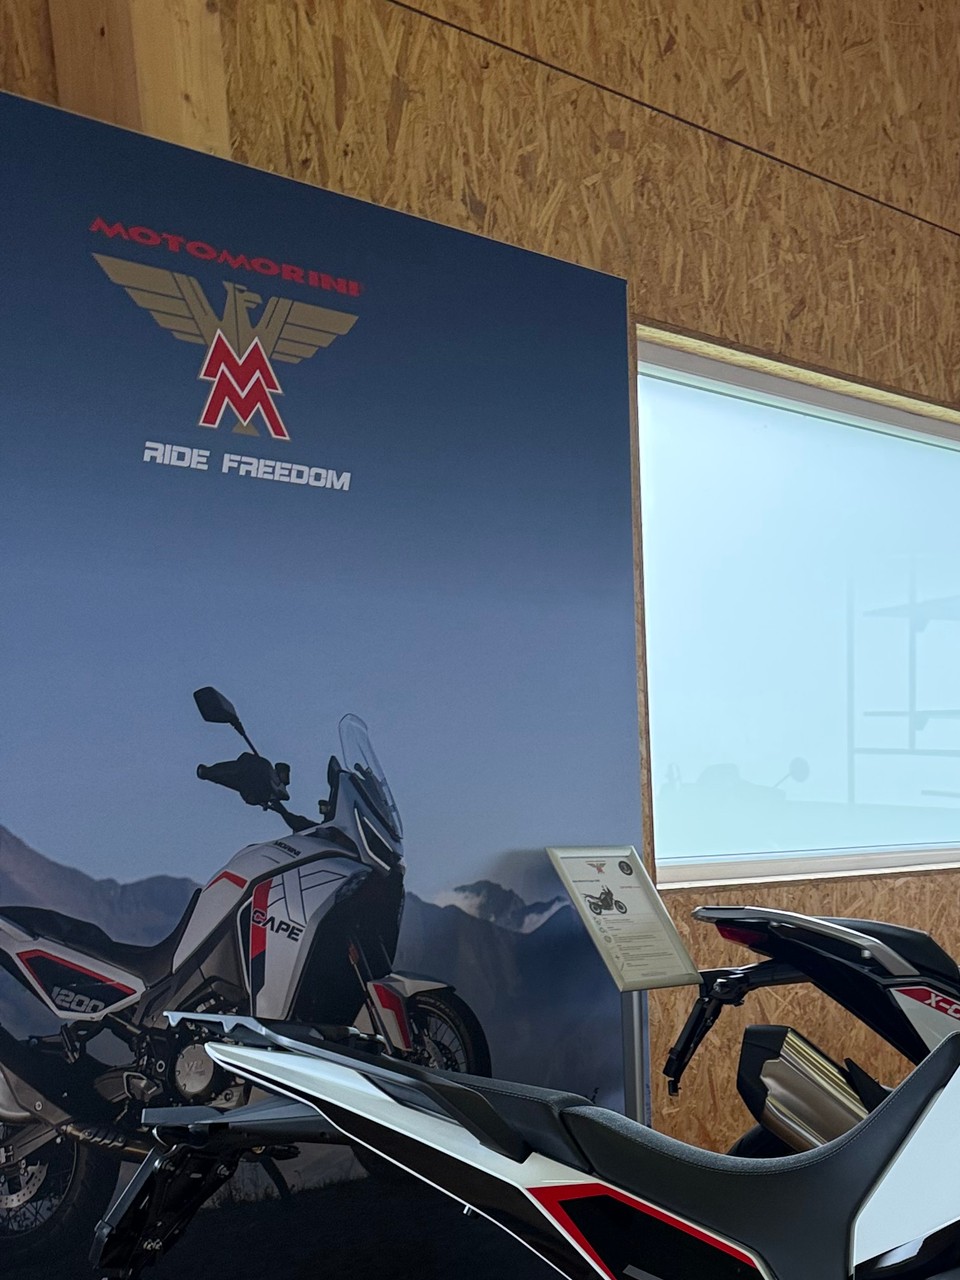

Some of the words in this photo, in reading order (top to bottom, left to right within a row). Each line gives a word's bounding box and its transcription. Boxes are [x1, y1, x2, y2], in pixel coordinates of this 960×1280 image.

[143, 441, 211, 470] RIDE
[221, 453, 352, 491] FREEDOM
[252, 909, 303, 942] CAPE
[52, 986, 106, 1013] 1200
